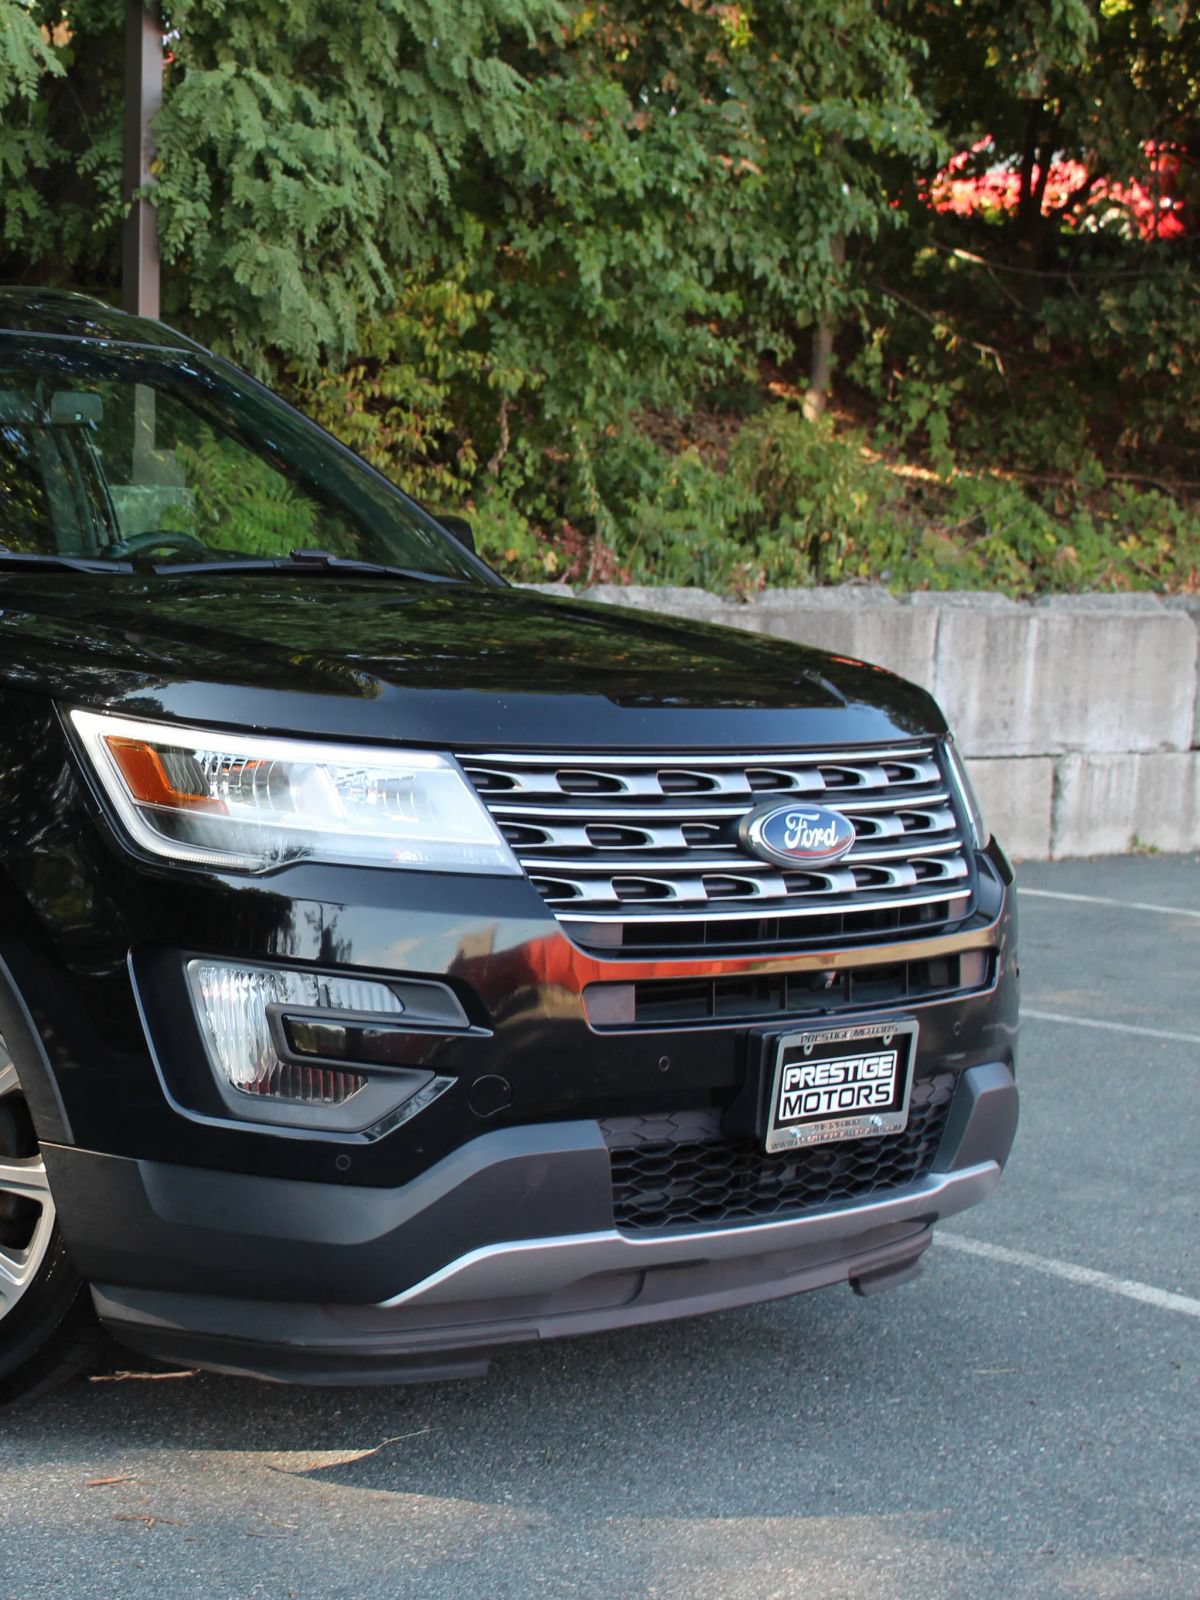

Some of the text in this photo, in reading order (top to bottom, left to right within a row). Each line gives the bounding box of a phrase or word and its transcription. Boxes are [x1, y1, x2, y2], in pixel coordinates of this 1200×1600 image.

[784, 812, 839, 849] Ford
[800, 1024, 898, 1043] PRESTIGE MOTORS
[785, 1055, 894, 1091] PRESTIGE
[783, 1083, 891, 1117] MOTORS
